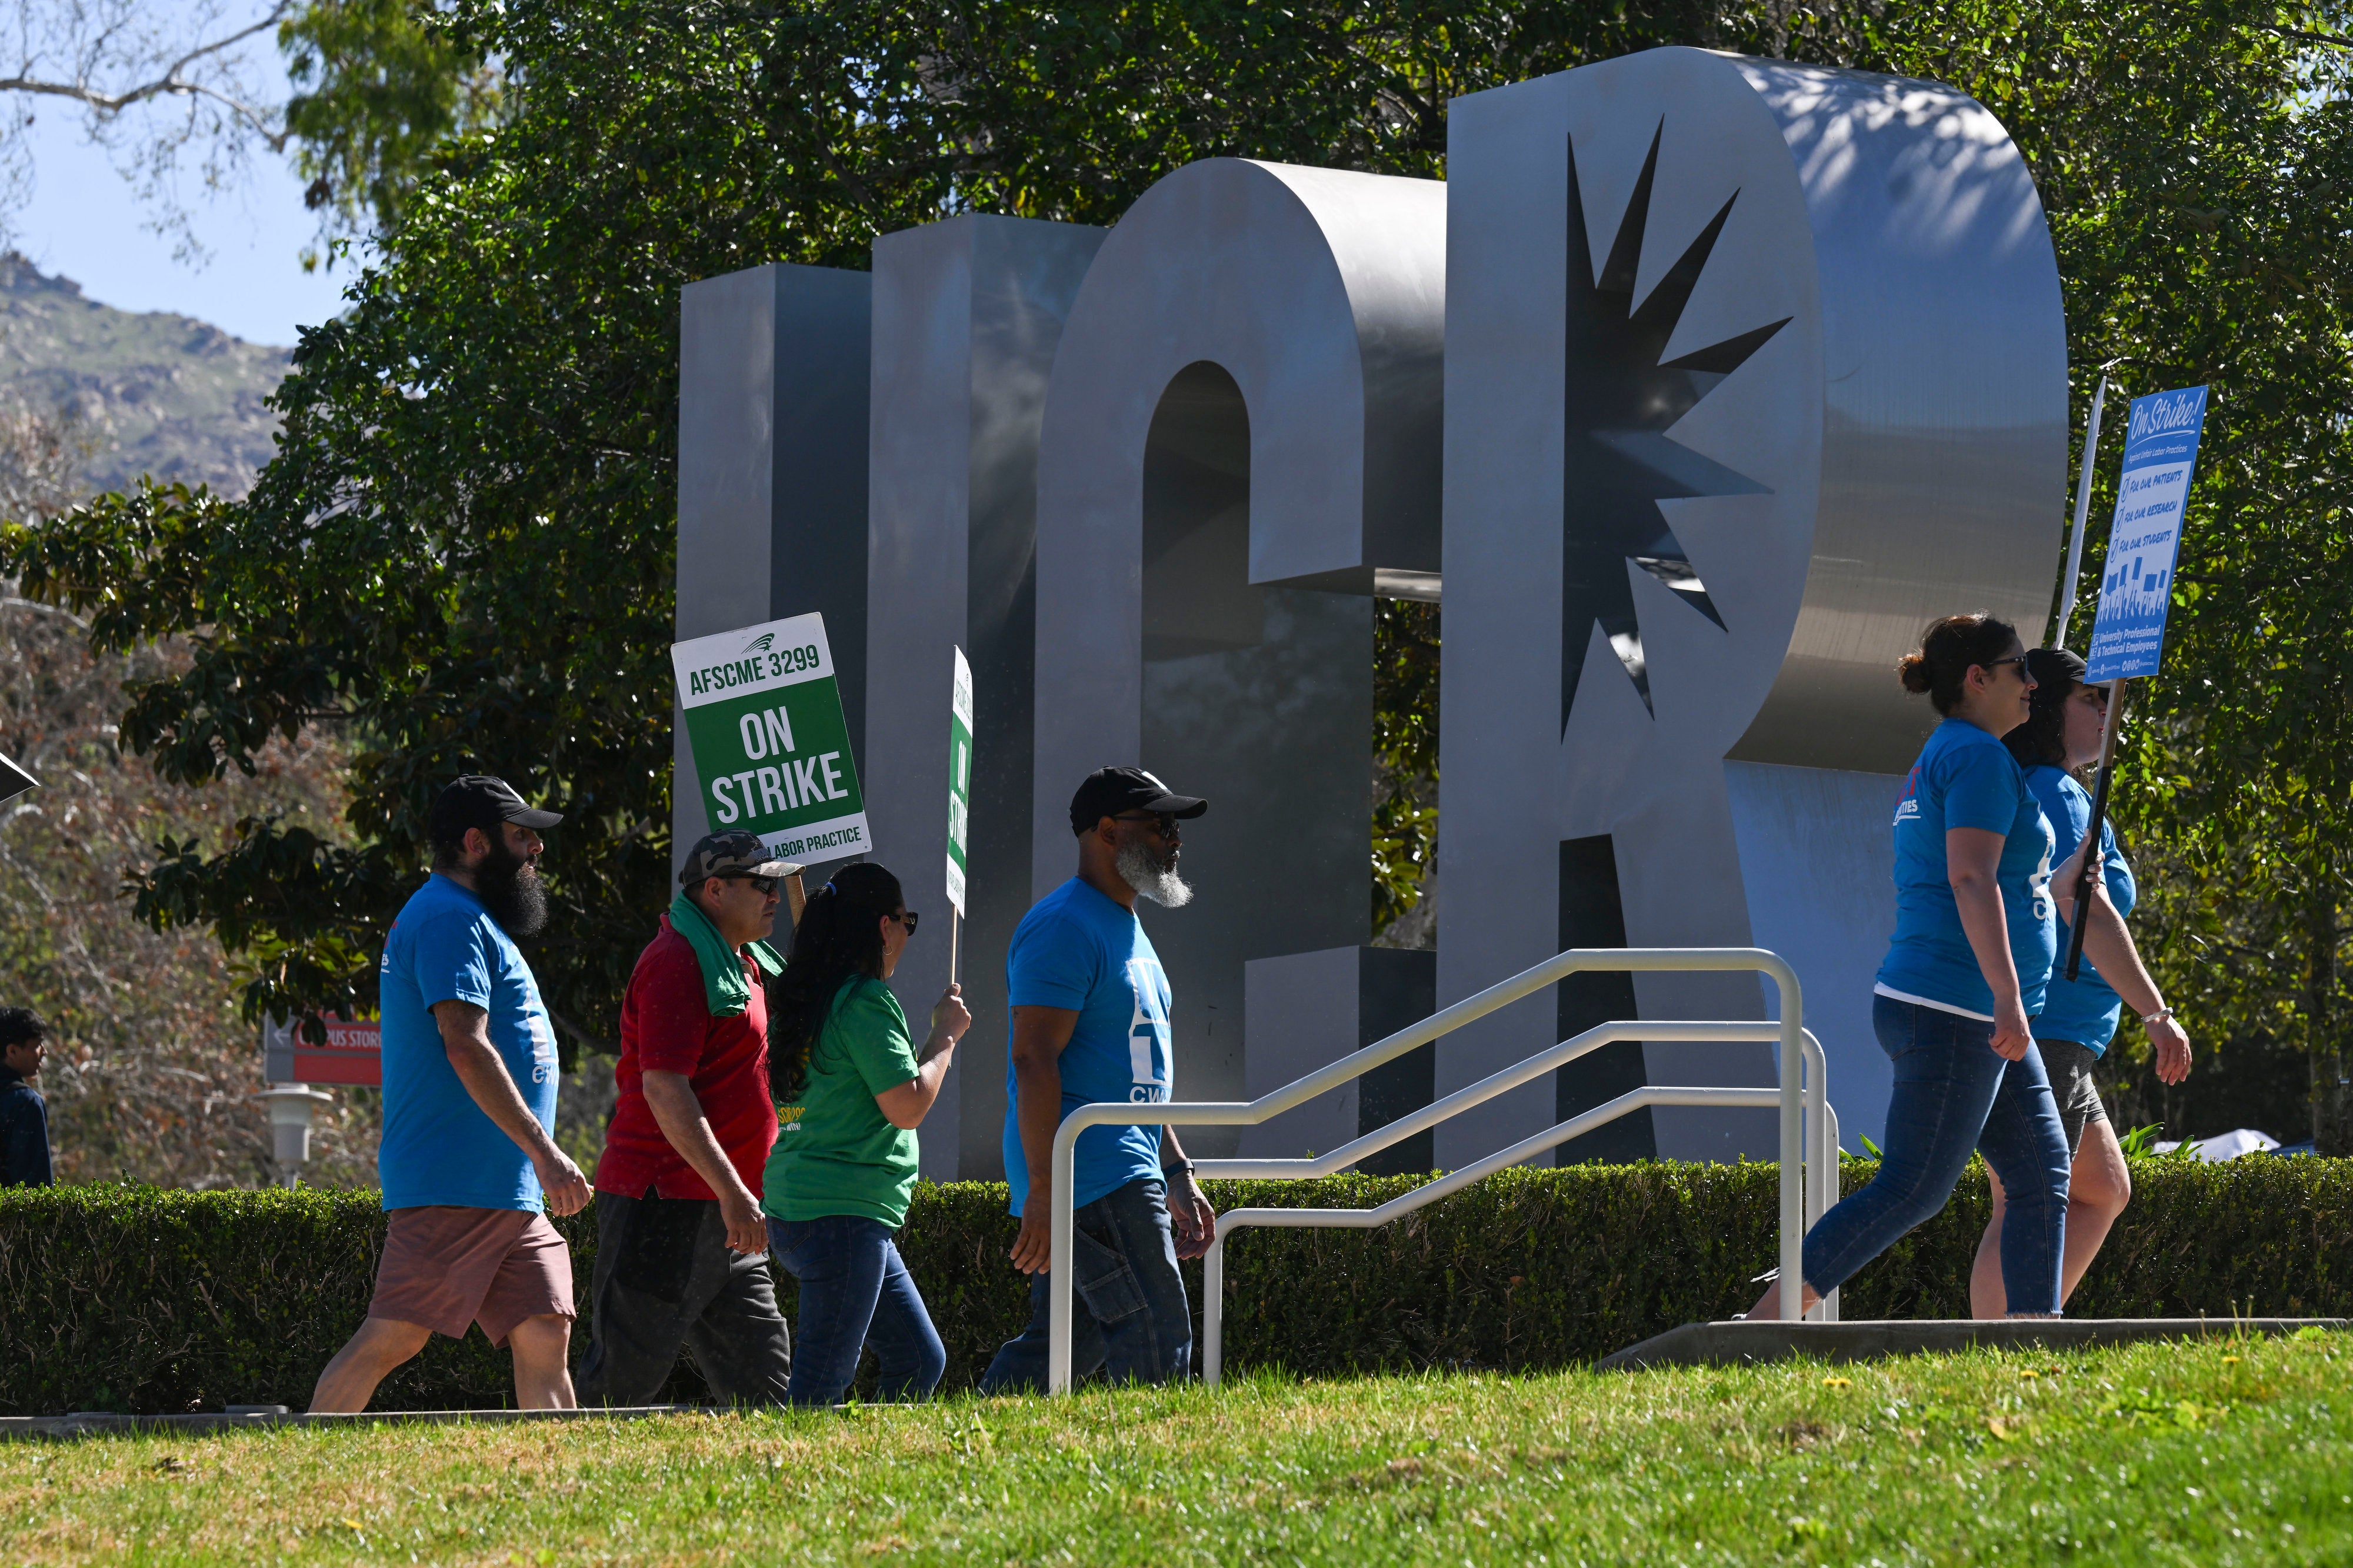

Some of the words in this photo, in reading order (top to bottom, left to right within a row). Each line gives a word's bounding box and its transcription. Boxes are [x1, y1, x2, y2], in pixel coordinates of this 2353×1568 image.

[2131, 404, 2148, 441] On
[2148, 391, 2204, 434] Strike!
[2128, 455, 2141, 464] Against
[2141, 451, 2152, 459] Unfair
[2152, 448, 2165, 457] Labor
[2166, 444, 2188, 455] Practices
[2129, 479, 2139, 493] FOR
[2140, 477, 2151, 489] OUR
[2153, 469, 2182, 486] PATIENTS
[2124, 511, 2134, 523] FOR
[2135, 508, 2146, 519] OUR
[2147, 500, 2178, 516] RESEARCH
[2119, 539, 2129, 552] FOR
[2130, 536, 2141, 549] OUR
[2142, 530, 2171, 547] STUDENTS
[2099, 629, 2124, 643] University
[2124, 625, 2161, 639] Professional
[2097, 647, 2102, 658] &
[2102, 642, 2125, 656] Technical
[2125, 640, 2158, 654] Employees
[690, 656, 766, 696] AFSCME
[769, 645, 820, 676] 3299
[739, 706, 795, 760] ON
[958, 740, 966, 795] ON
[712, 750, 848, 824] STRIKE
[949, 789, 968, 859] STRIKE
[806, 826, 862, 852] PRACTICE
[299, 1028, 347, 1046] CPUS
[1129, 1086, 1171, 1103] CW
